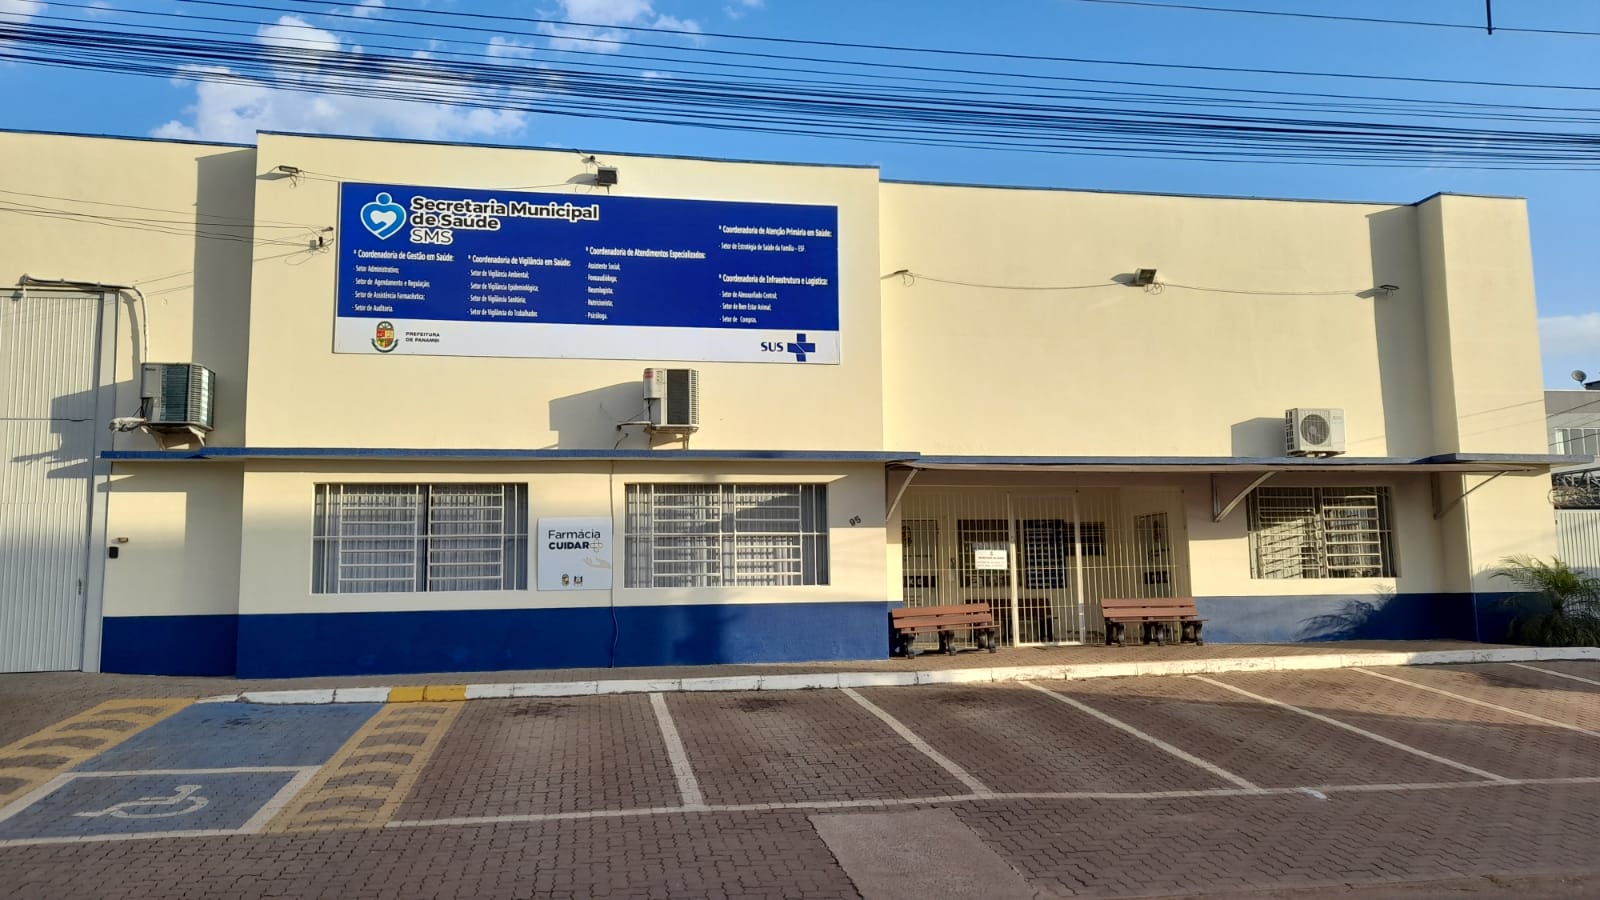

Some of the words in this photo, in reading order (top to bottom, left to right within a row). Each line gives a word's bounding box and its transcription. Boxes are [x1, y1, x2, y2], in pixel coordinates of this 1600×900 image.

[412, 197, 506, 216] Secretaria
[511, 202, 598, 222] Municipal
[412, 213, 436, 226] de
[441, 215, 499, 229] Saúde
[412, 229, 452, 243] SMS
[723, 225, 758, 234] Coordenadoria
[766, 227, 785, 236] Atenção
[786, 228, 806, 236] Primária
[358, 250, 397, 259] Coordenadoria
[399, 251, 405, 259] de
[407, 252, 425, 260] Gestão
[590, 247, 626, 256] Coordenadoria
[627, 248, 634, 256] de
[635, 248, 668, 258] Atendimentos
[472, 255, 510, 264] Coordenadoria
[519, 257, 543, 266] Vigilância
[761, 342, 784, 352] SUS
[548, 529, 600, 539] Farmácia
[548, 542, 589, 550] CUIDAR
